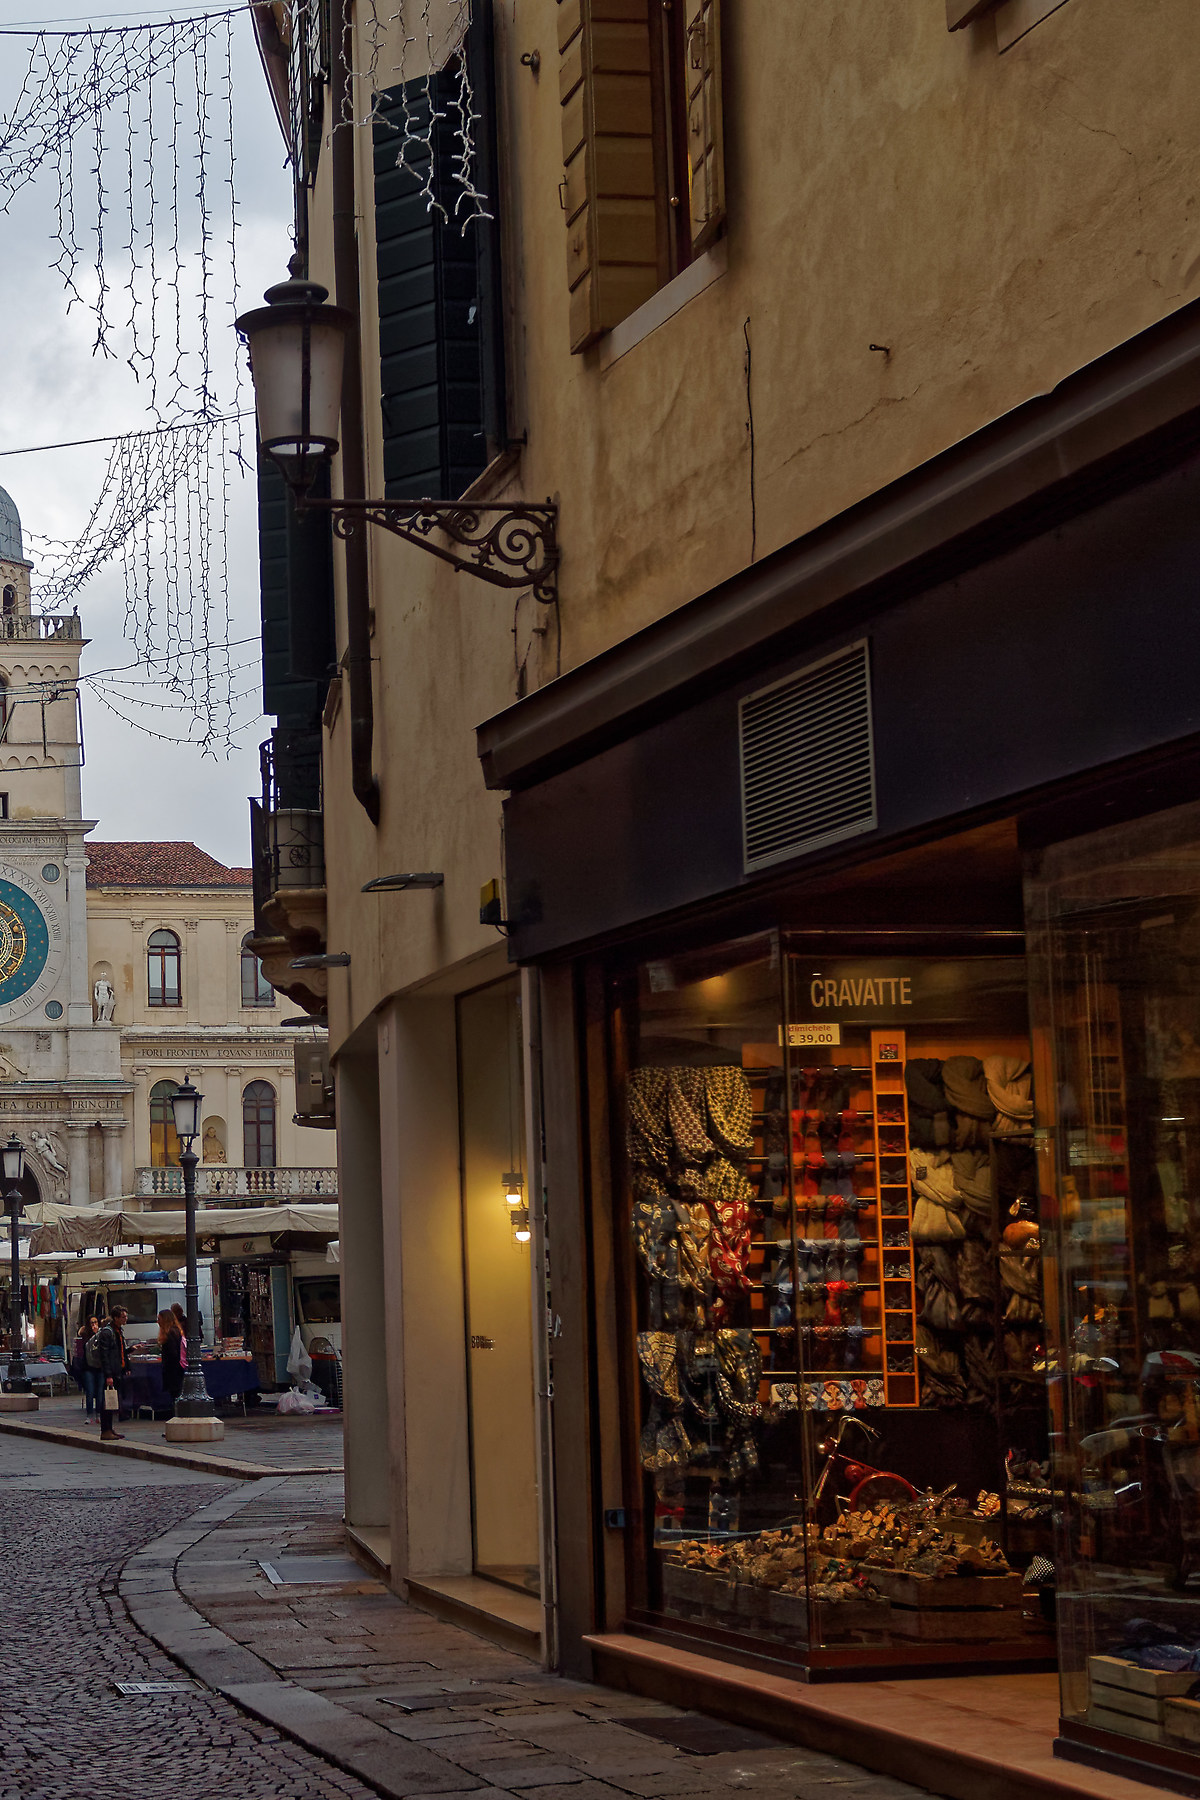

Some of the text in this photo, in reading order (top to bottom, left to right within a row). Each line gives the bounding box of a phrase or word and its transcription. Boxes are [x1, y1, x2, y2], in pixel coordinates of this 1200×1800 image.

[810, 977, 913, 1008] CRAVATTE
[800, 1034, 833, 1044] 39,00
[142, 1049, 163, 1057] FORI
[167, 1049, 209, 1057] FRONTEM
[72, 1100, 121, 1109] PRINCIPE
